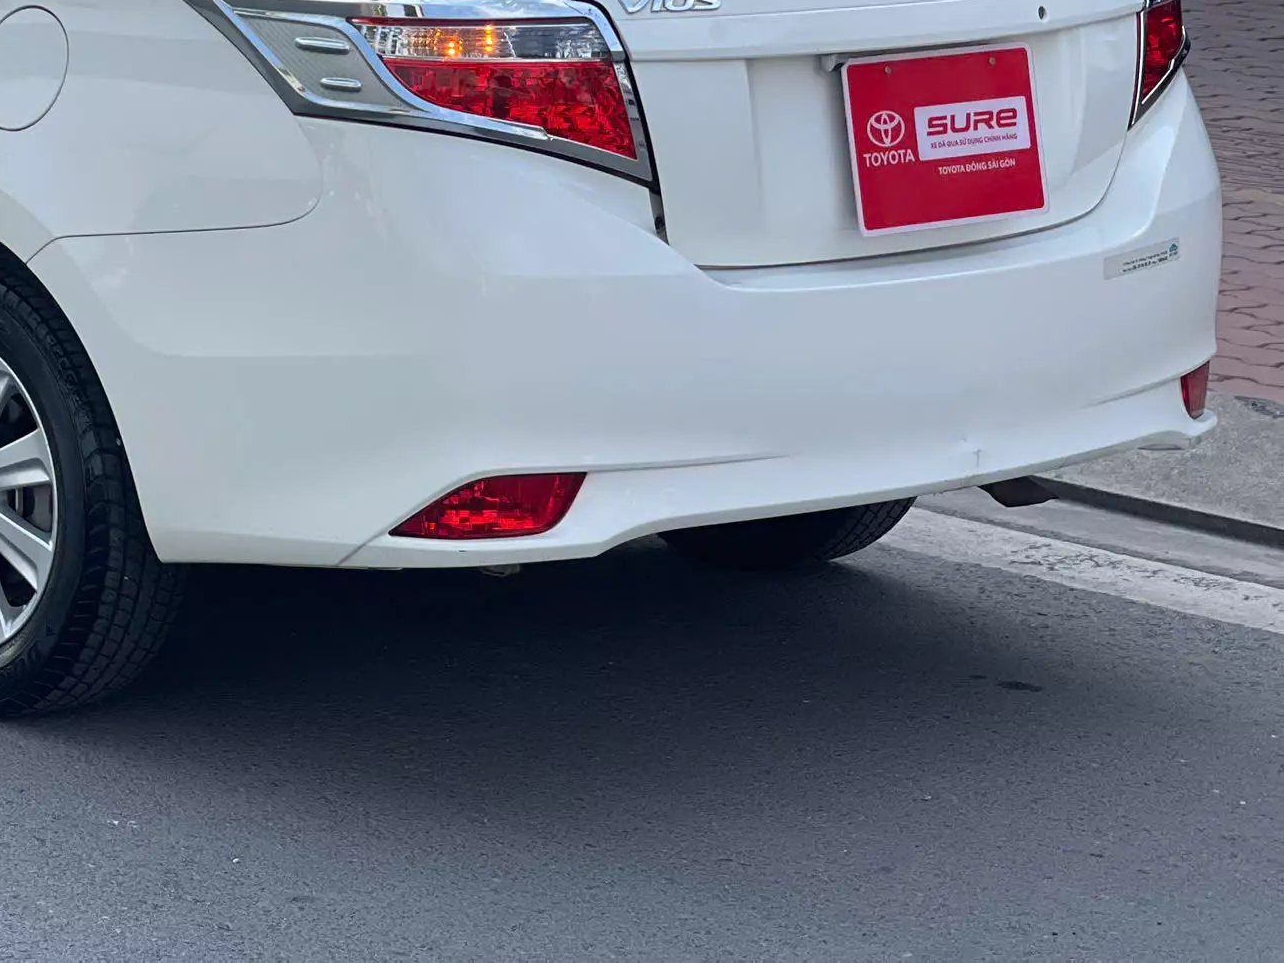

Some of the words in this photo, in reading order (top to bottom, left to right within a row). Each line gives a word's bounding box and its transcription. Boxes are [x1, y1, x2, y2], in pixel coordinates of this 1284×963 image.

[947, 139, 959, 147] QUA
[863, 148, 915, 167] TOYOTA
[938, 164, 966, 175] TOYOTA
[966, 160, 987, 172] ĐÔNG
[988, 158, 999, 169] SÀI
